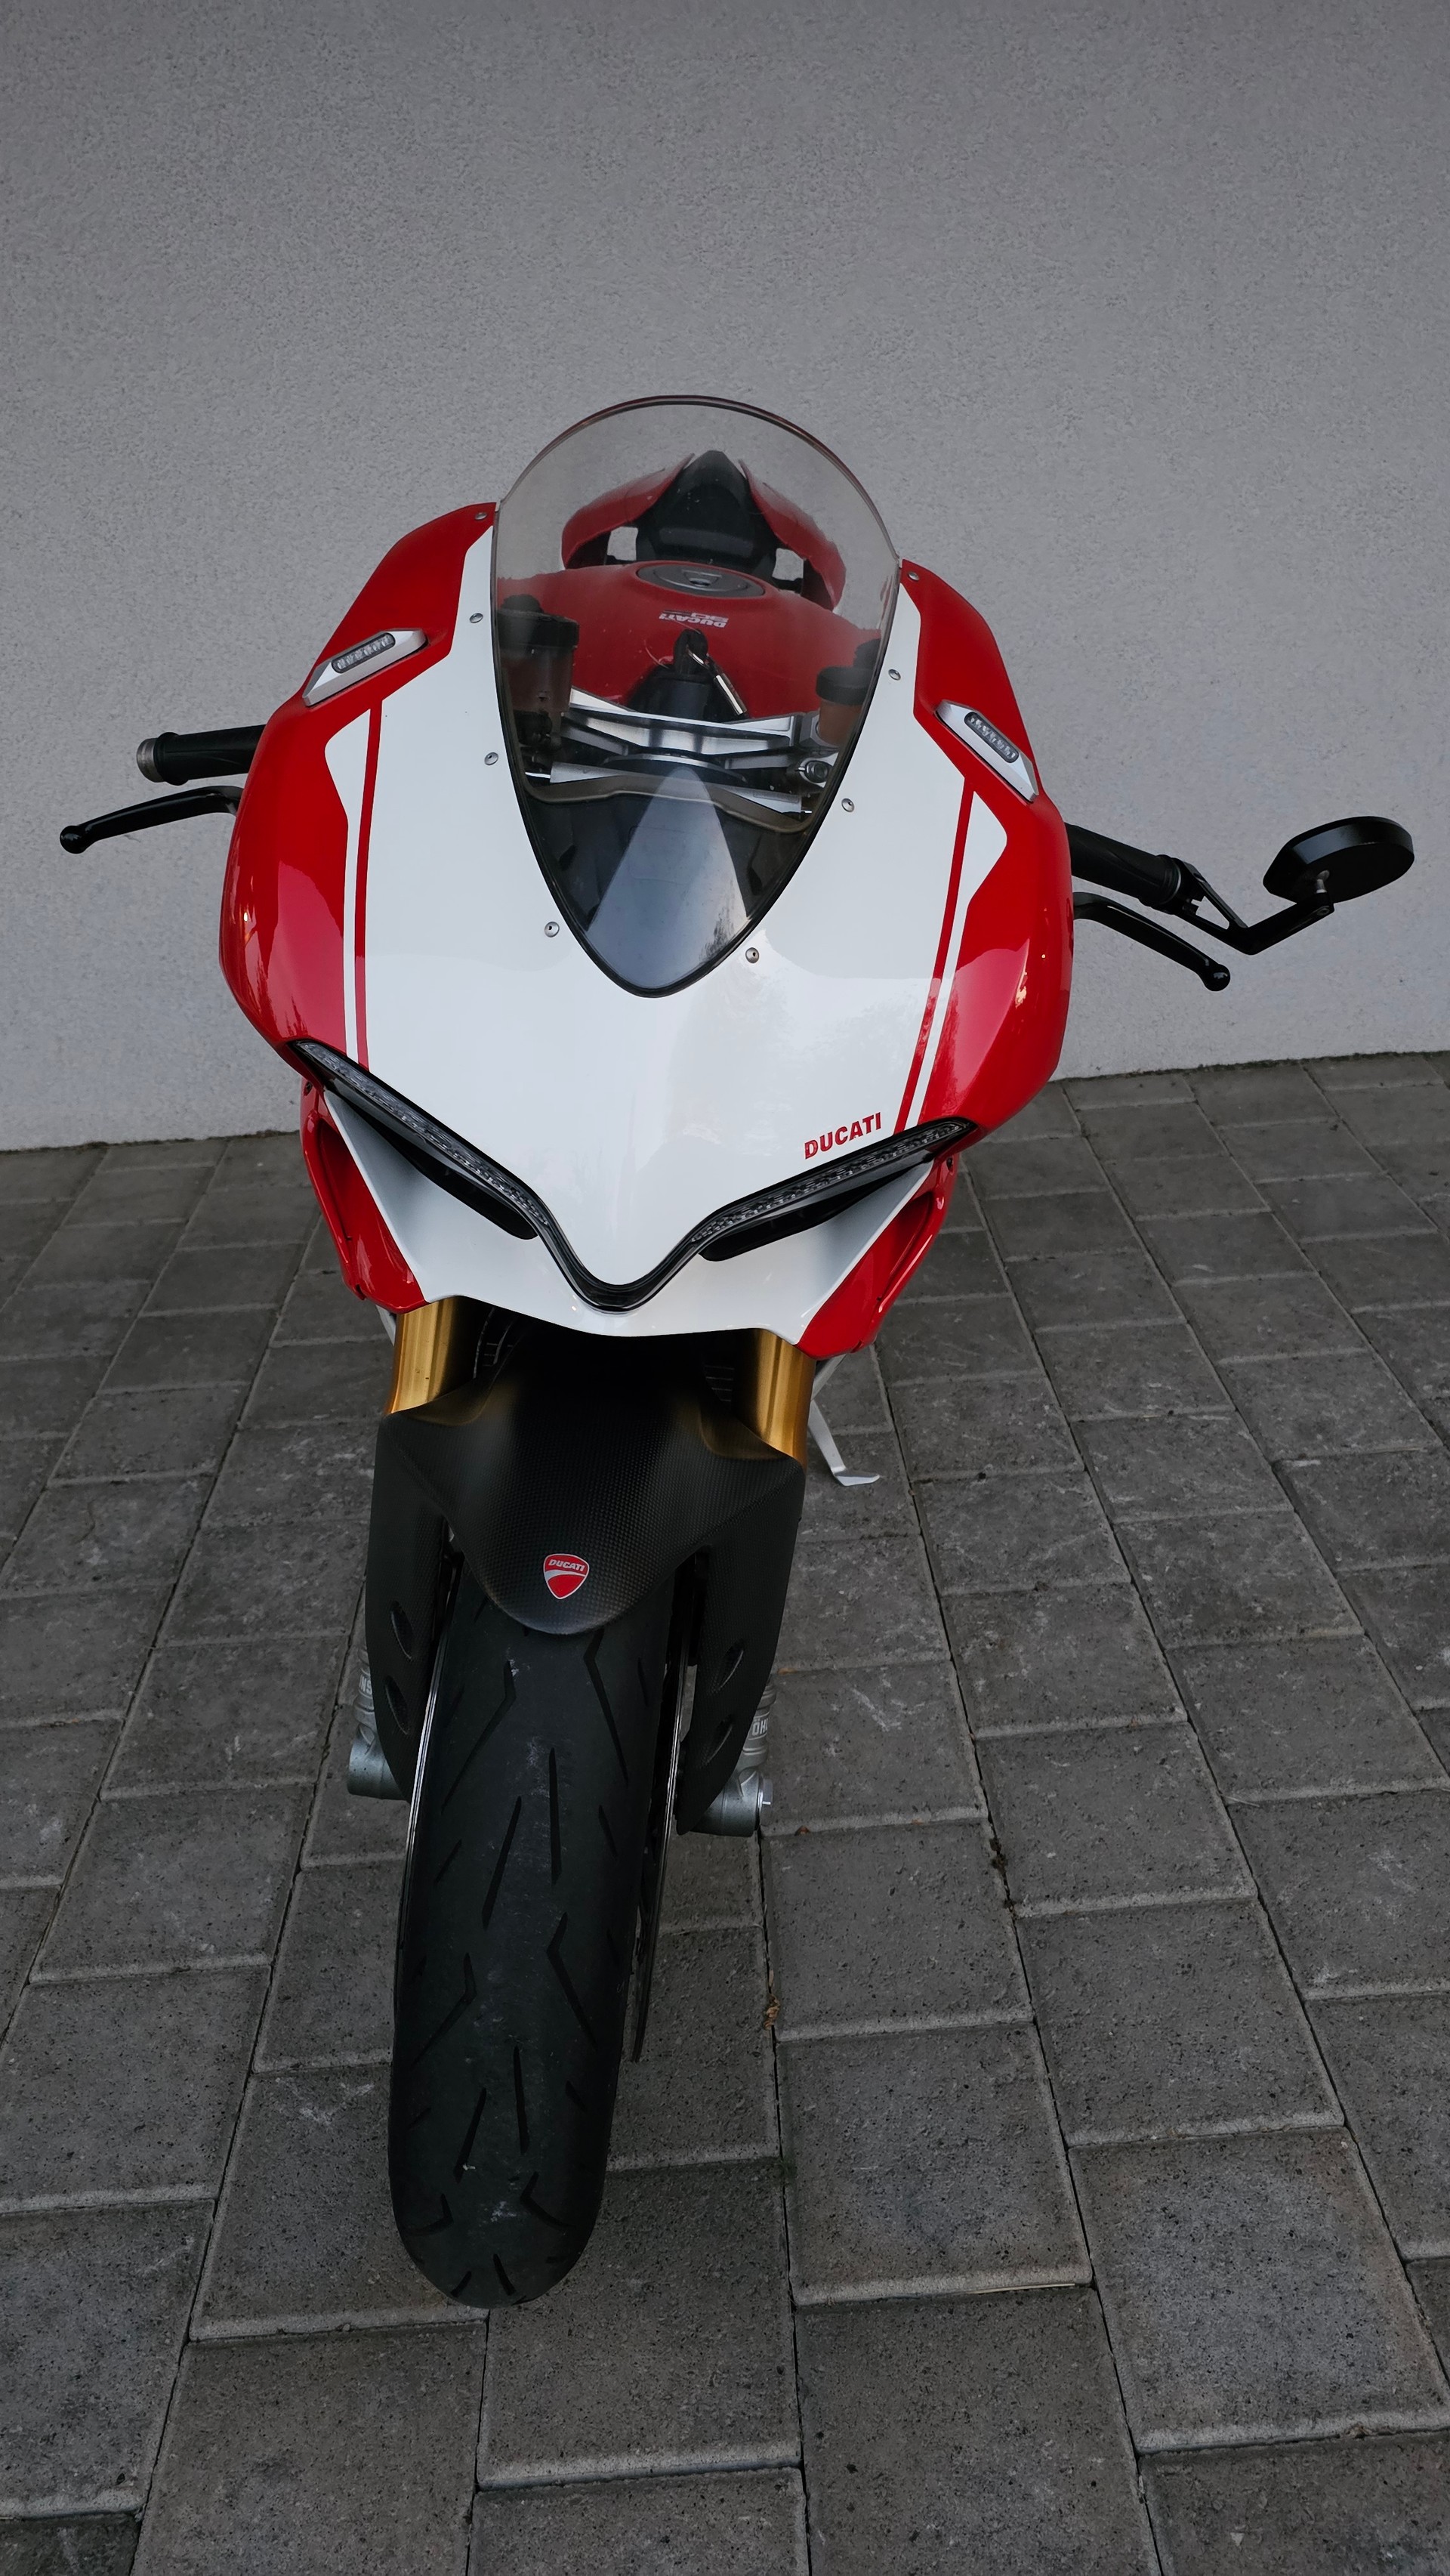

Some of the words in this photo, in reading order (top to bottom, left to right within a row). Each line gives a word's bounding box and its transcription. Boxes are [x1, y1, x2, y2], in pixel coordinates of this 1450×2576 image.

[659, 613, 727, 628] DUCATI
[804, 1112, 881, 1160] DUCATI
[548, 1559, 585, 1572] DUCATI
